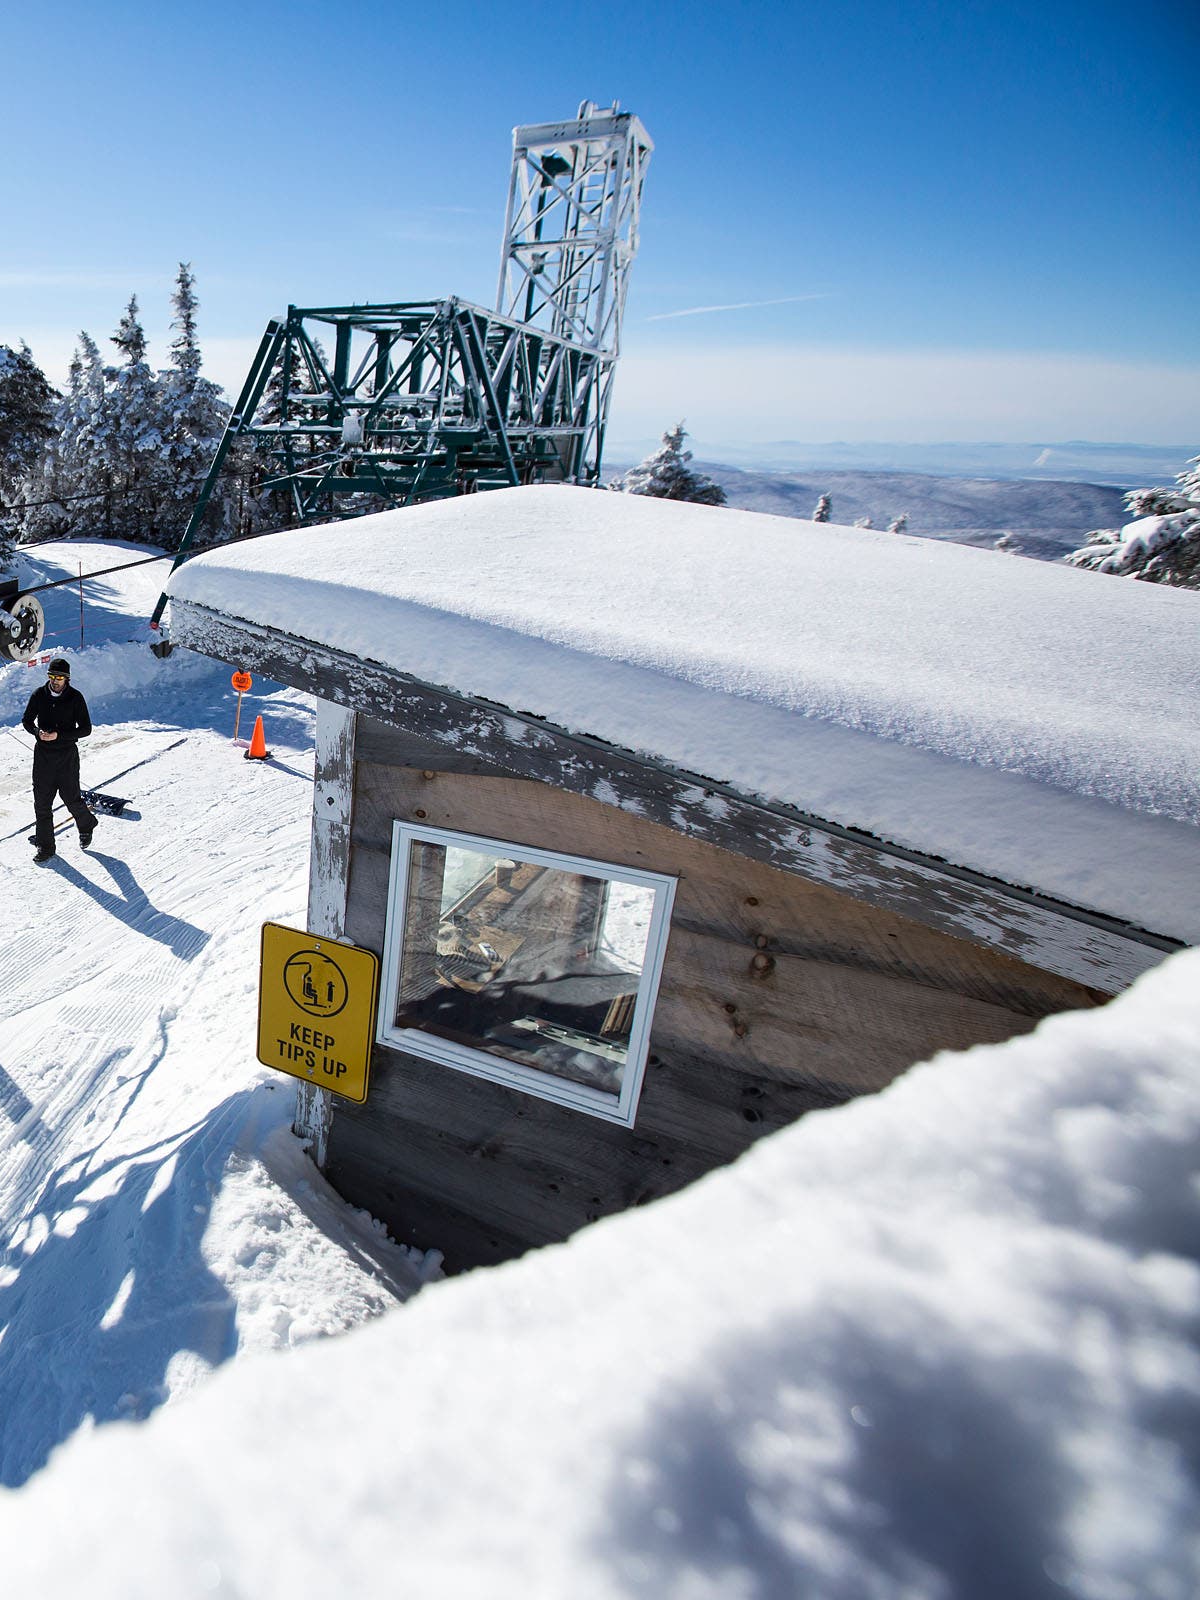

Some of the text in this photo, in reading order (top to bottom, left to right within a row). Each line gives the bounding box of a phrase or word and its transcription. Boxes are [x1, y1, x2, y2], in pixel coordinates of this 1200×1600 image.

[290, 1022, 335, 1051] KEEP
[277, 1039, 347, 1078] TIPS UP
